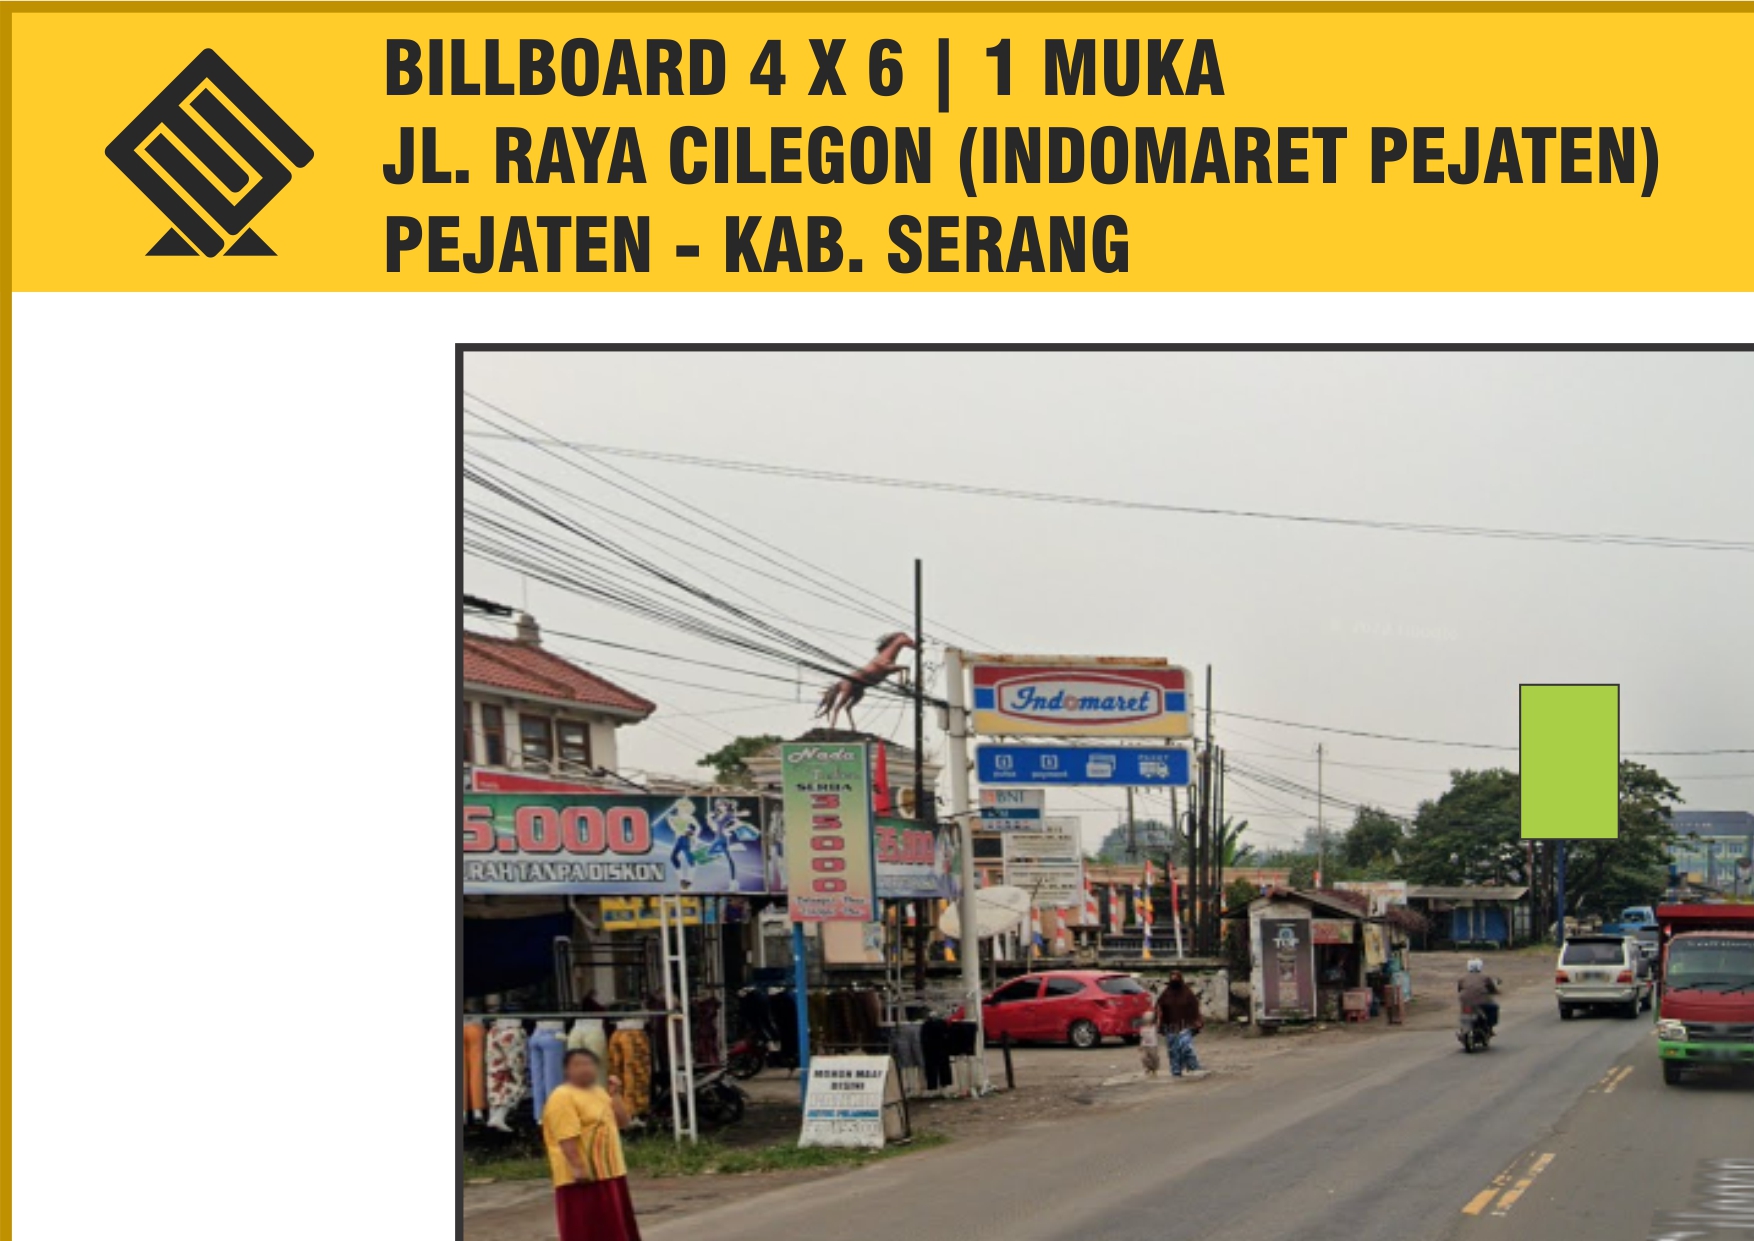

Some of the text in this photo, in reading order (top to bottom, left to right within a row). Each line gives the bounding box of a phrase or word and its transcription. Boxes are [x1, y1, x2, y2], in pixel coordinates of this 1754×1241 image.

[387, 38, 1224, 96] BILLBOARD 4 X 6 1 MUKA
[383, 126, 1658, 197] JL. RAYA CILEGON (INDOMARET PEJATEN)
[387, 215, 1128, 273] PEJATEN KAB. SERANG
[1011, 686, 1149, 711] Indomaret
[997, 791, 1024, 804] BNI
[463, 861, 665, 882] RAH TANPA DISKON
